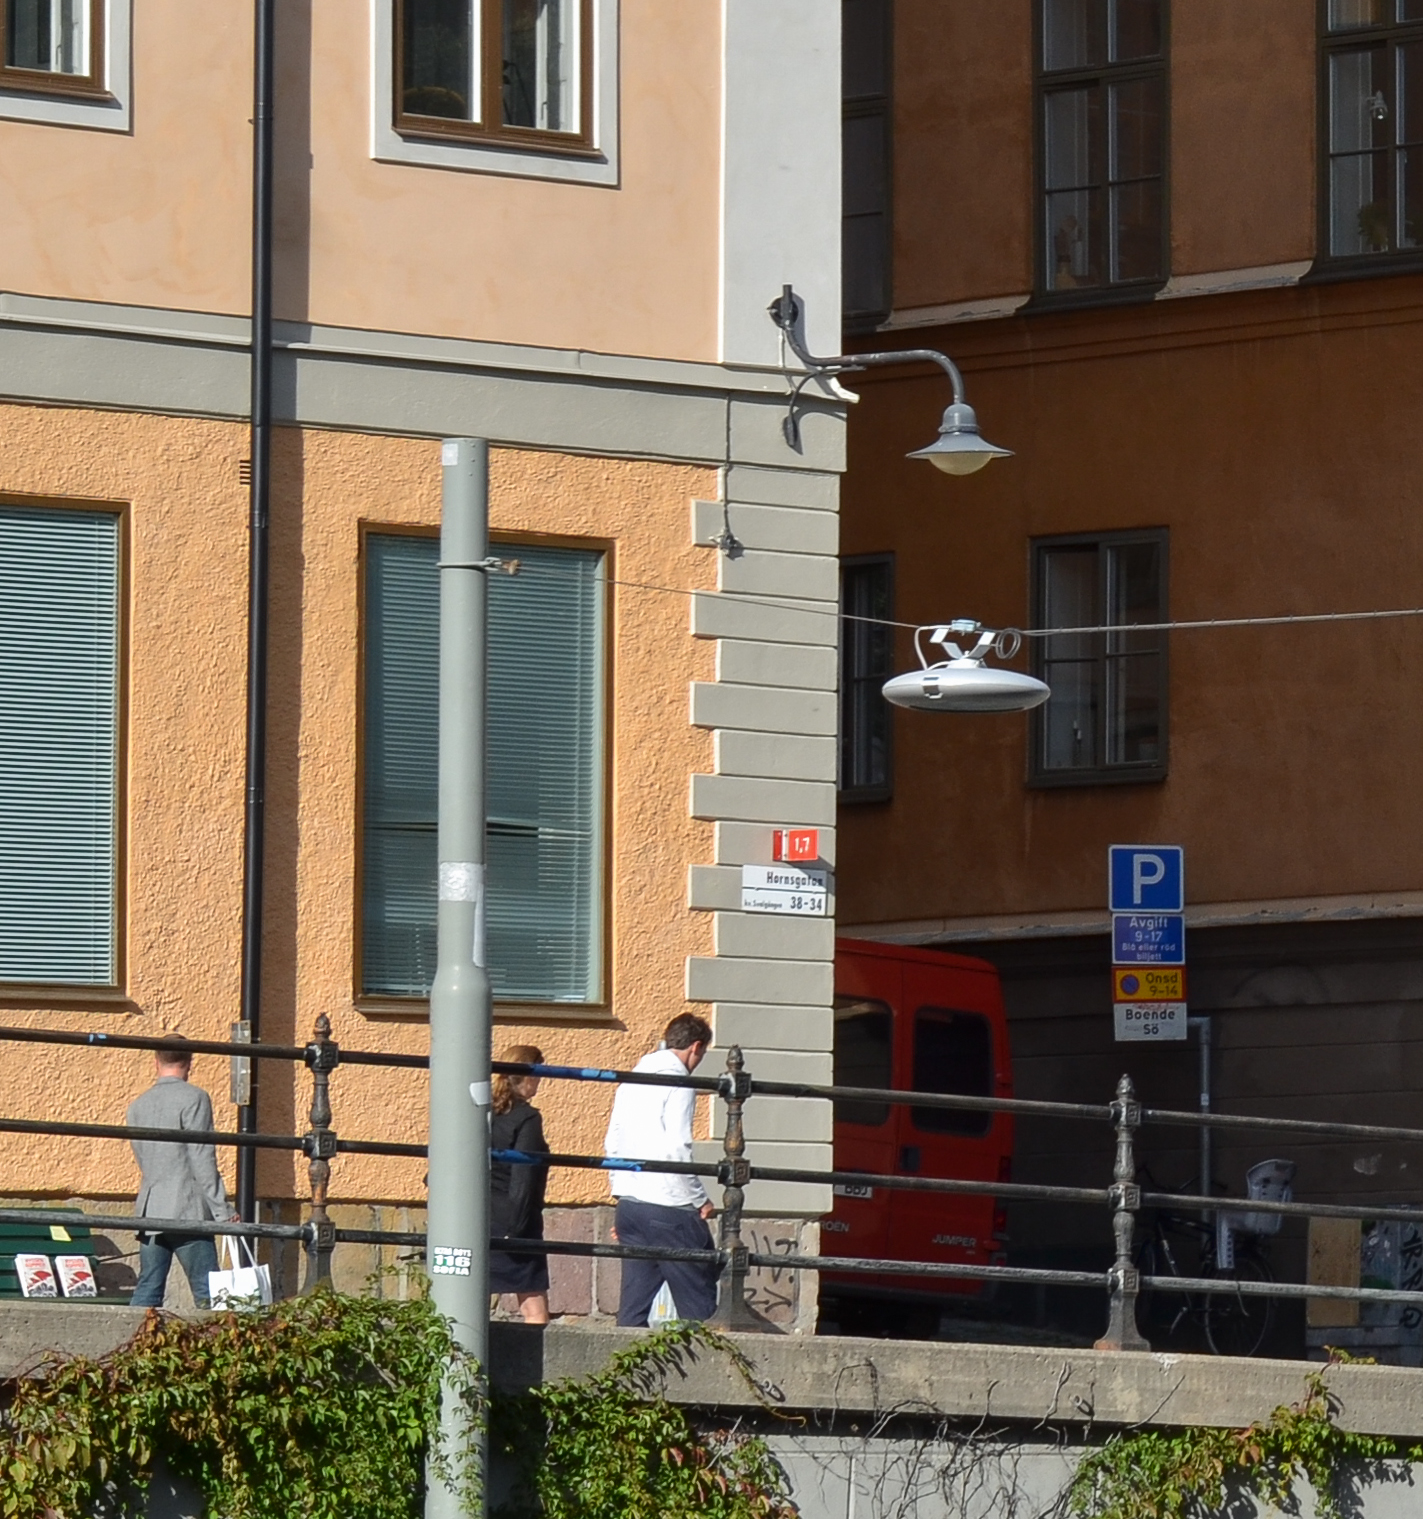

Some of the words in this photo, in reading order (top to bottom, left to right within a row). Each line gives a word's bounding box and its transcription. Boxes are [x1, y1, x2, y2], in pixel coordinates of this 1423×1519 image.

[767, 871, 824, 889] Hornsgatan
[1133, 853, 1165, 904] P
[790, 895, 823, 912] 38-34
[1129, 916, 1168, 931] Avgift
[1134, 930, 1163, 943] 9-17
[1145, 972, 1178, 984] Onsd
[1149, 985, 1178, 996] 9-14
[1125, 1008, 1176, 1021] Boende
[1143, 1022, 1159, 1035] Sö
[932, 1233, 976, 1247] JUMPER
